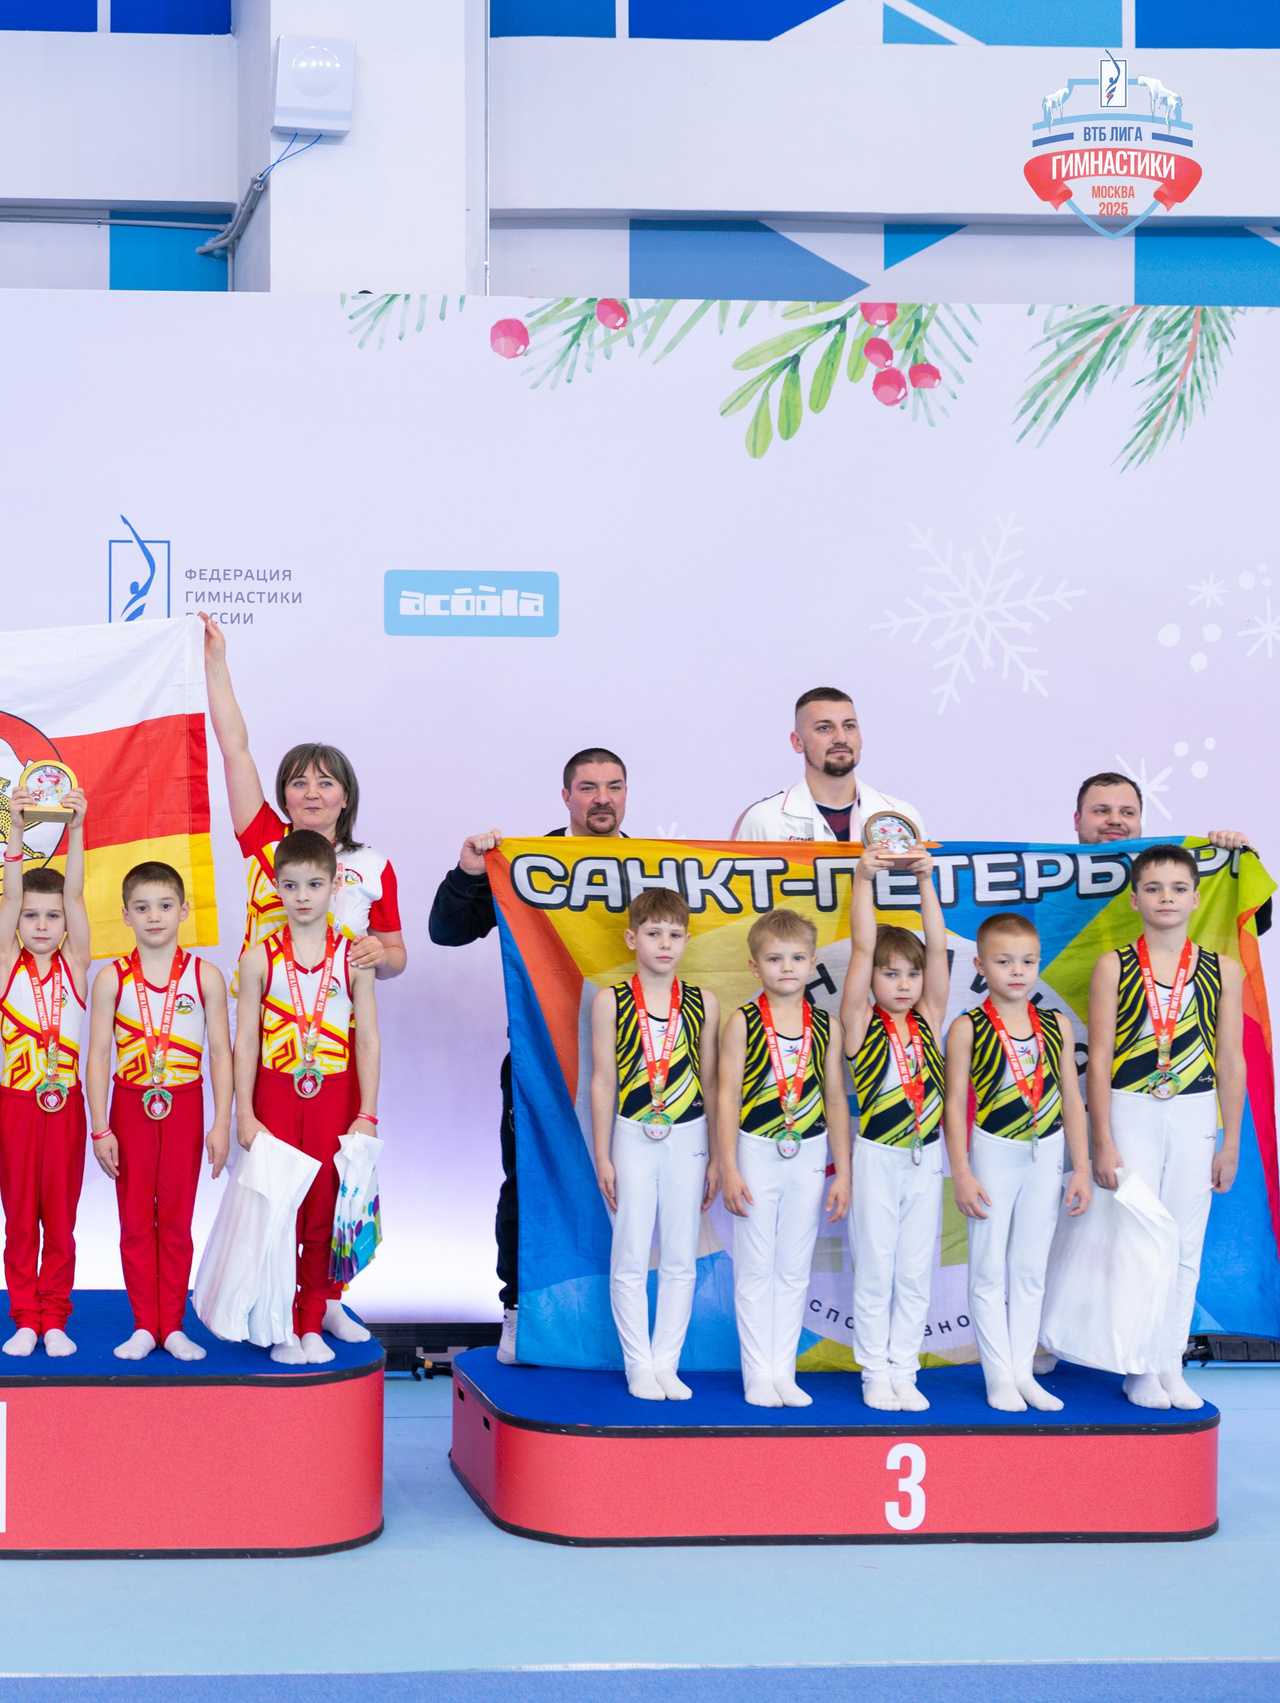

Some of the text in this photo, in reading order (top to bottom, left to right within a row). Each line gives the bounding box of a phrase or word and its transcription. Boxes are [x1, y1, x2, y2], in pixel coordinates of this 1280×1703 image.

[185, 568, 292, 583] ФЕДЕРАЦИЯ
[185, 591, 302, 604] ГИМНАСТИКИ
[185, 612, 254, 625] ССИИ
[511, 843, 1241, 914] САНКТ-ПЕТЕРБР
[884, 1442, 927, 1531] 3
